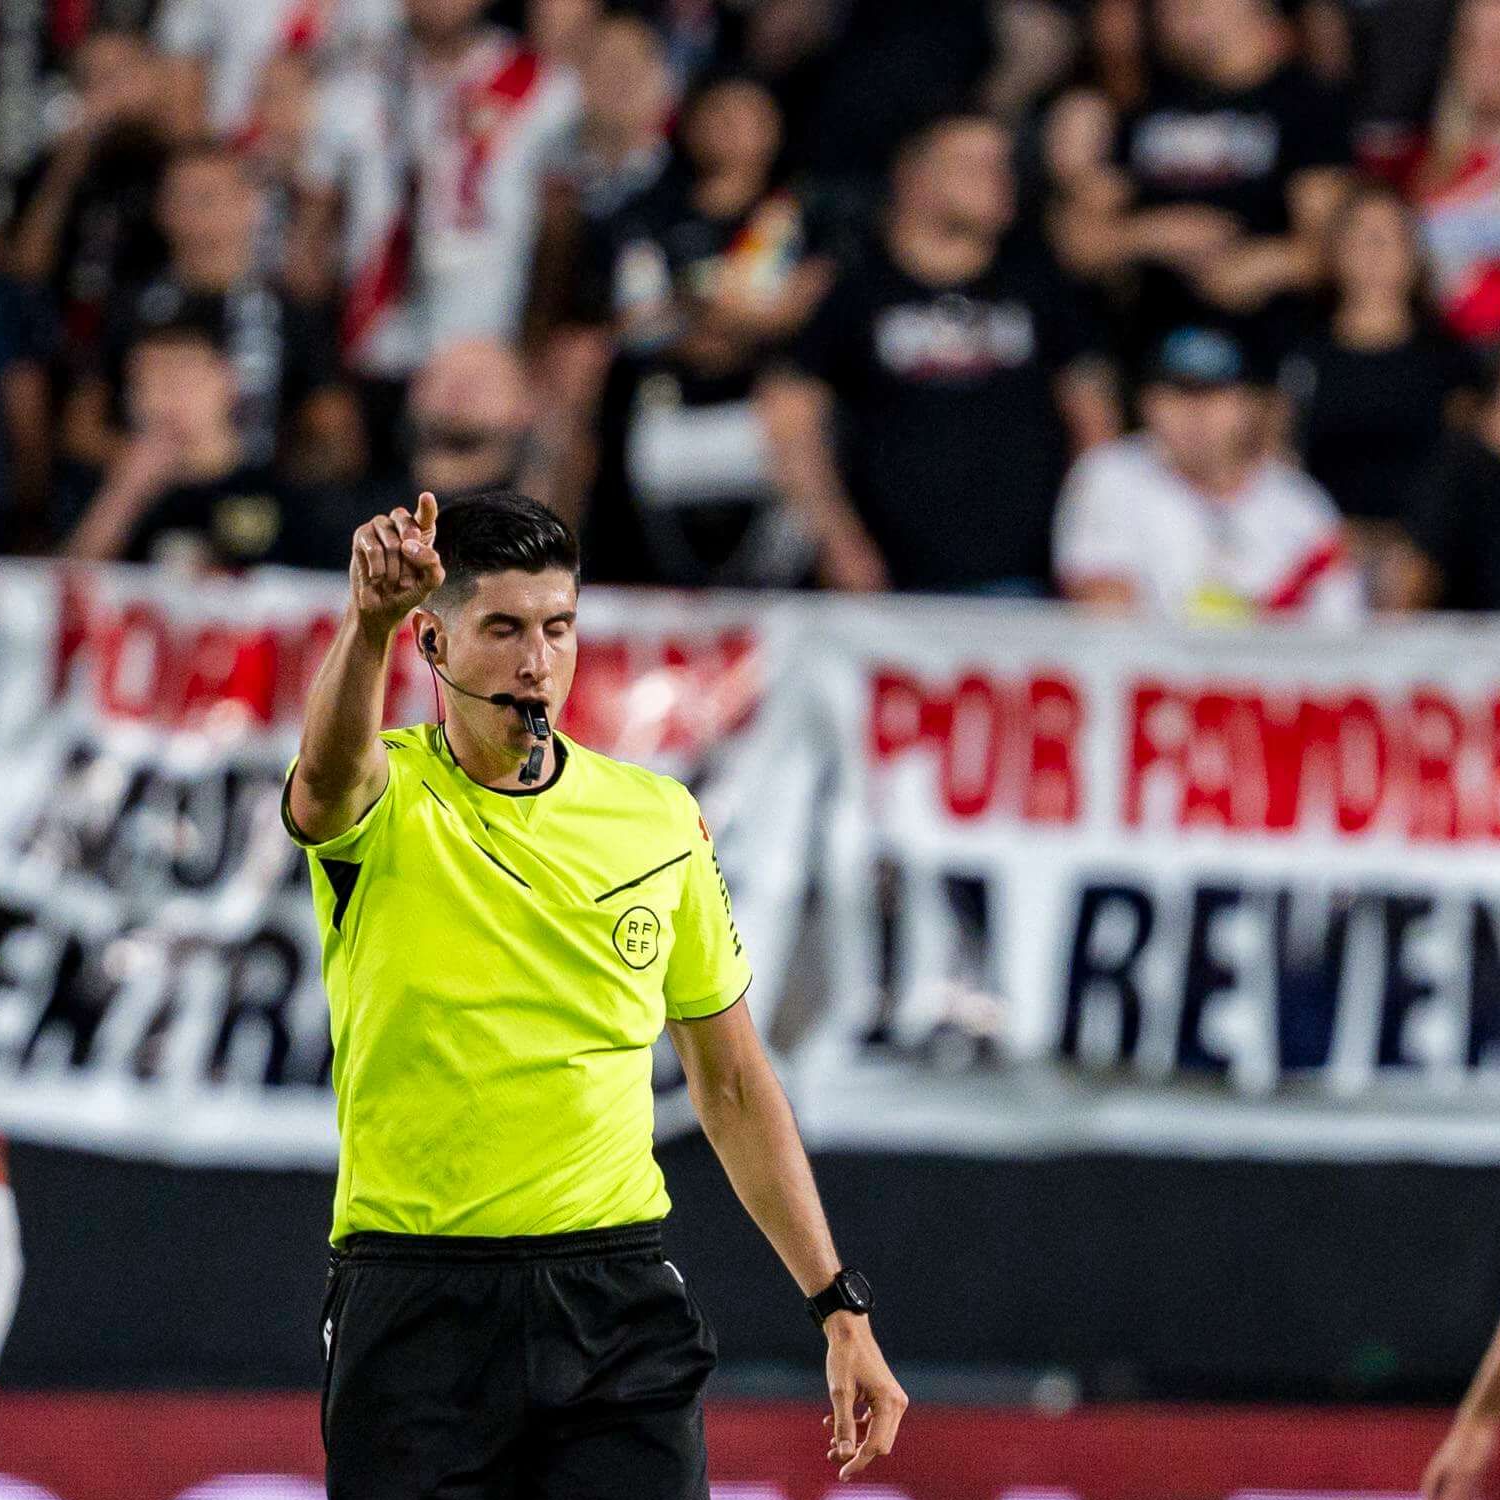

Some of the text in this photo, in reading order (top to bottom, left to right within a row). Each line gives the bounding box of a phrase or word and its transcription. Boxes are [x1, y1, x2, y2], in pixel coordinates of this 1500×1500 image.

[870, 670, 1080, 828] POR
[627, 920, 653, 935] RF
[626, 938, 650, 954] EF
